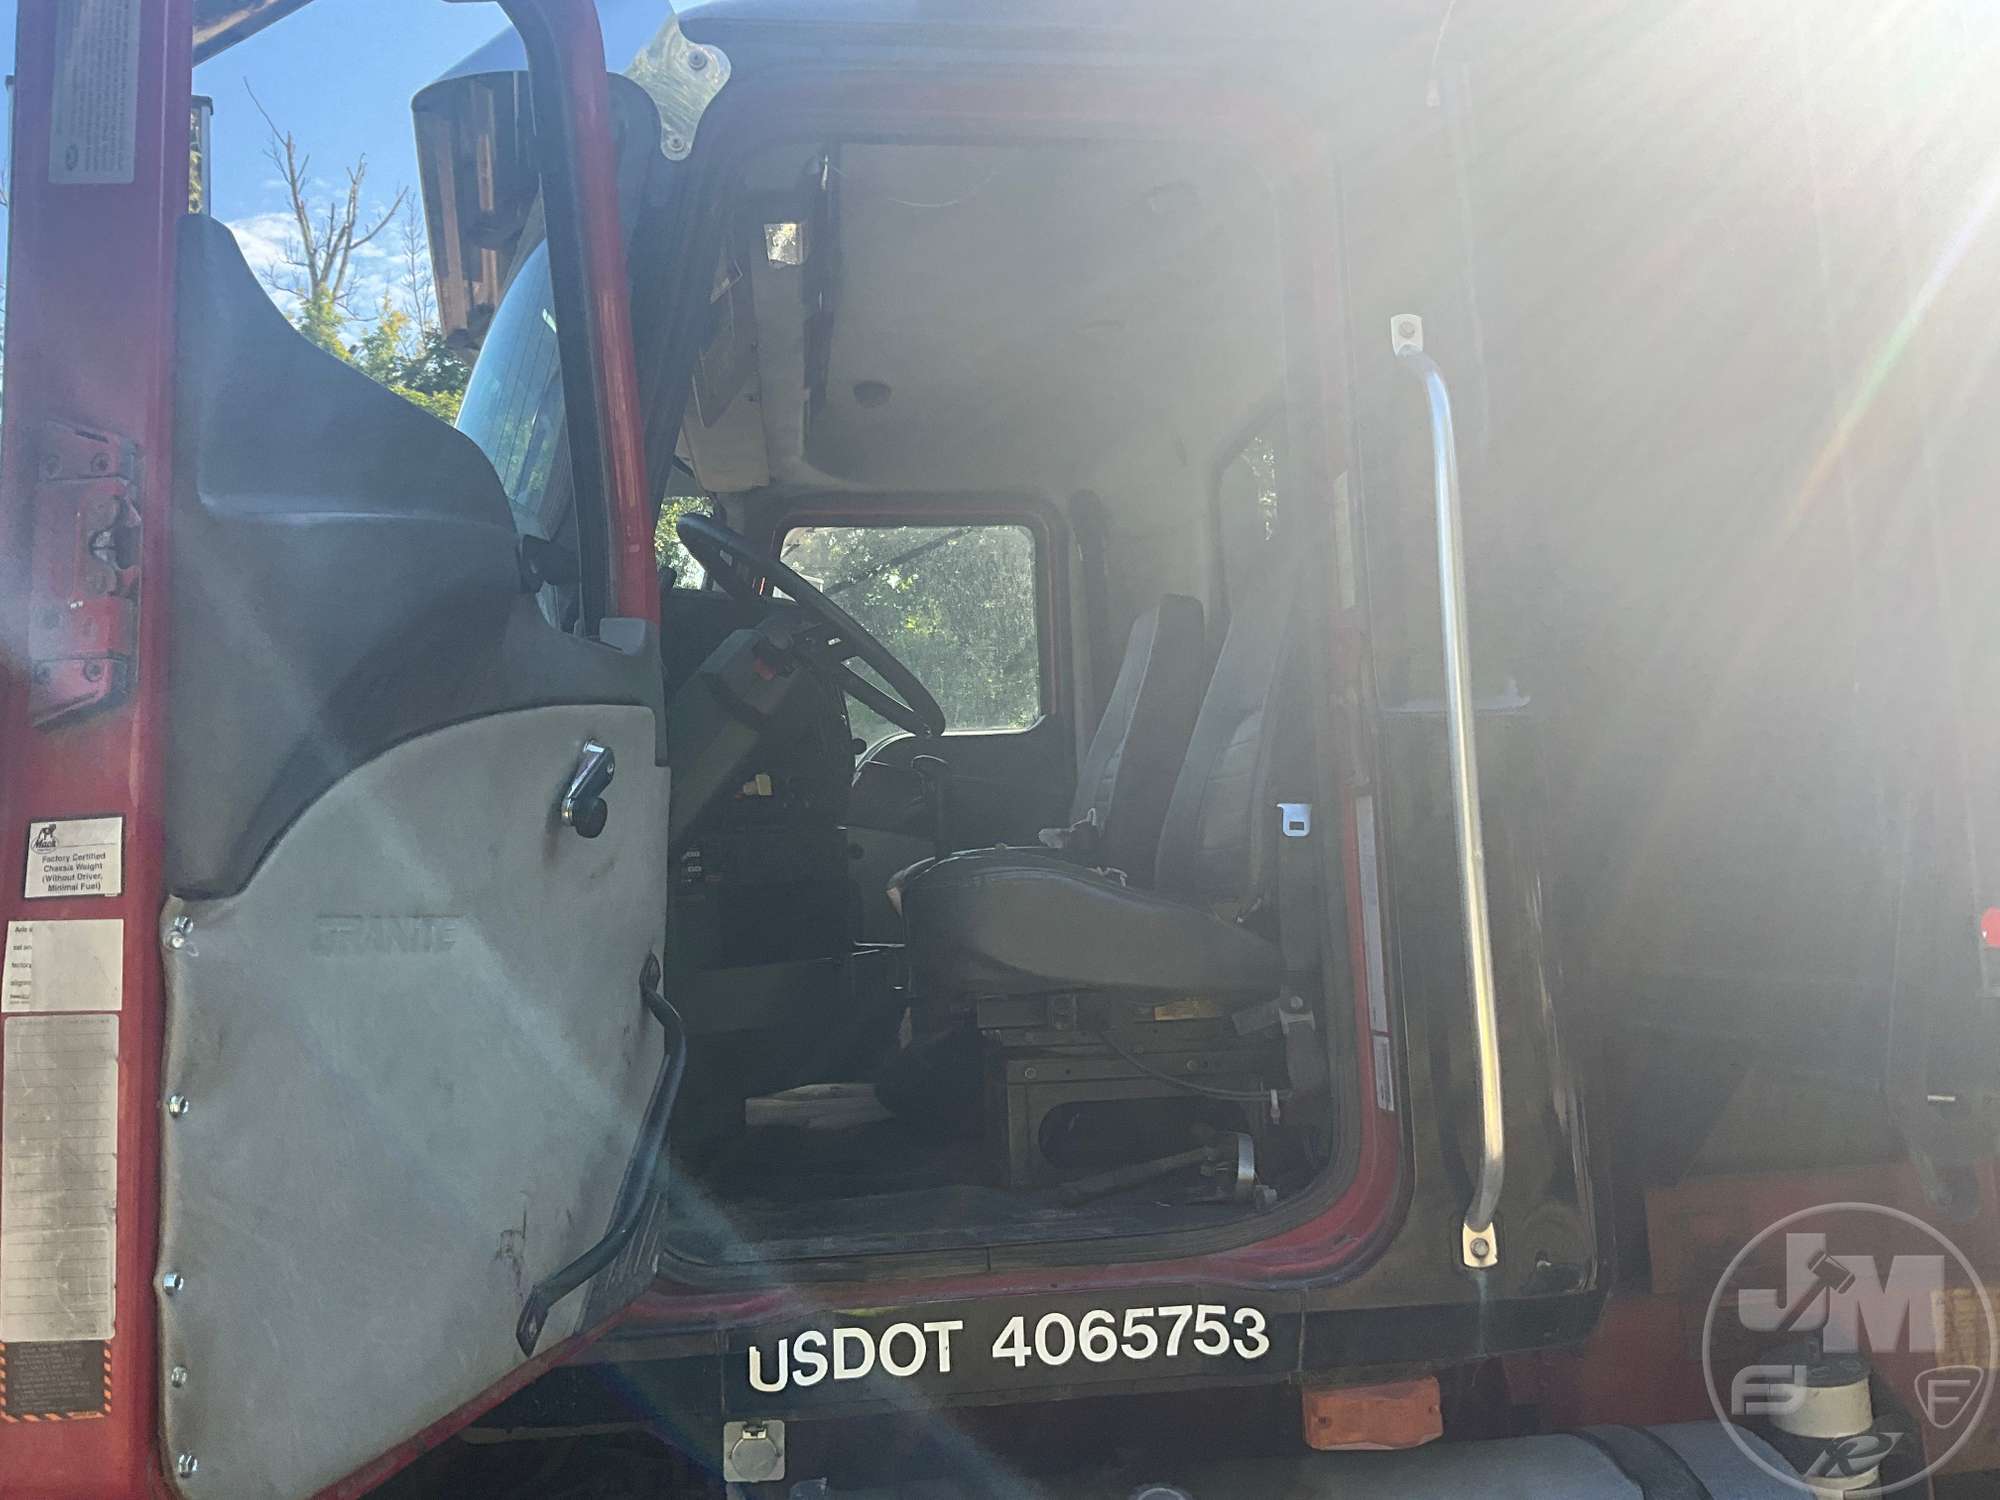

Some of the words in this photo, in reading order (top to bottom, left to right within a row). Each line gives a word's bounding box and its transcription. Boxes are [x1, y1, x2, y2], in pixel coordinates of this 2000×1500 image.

[42, 855, 70, 864] Factory
[72, 852, 106, 862] Certified
[43, 864, 73, 873] Chassis
[76, 862, 103, 872] Weight
[48, 883, 78, 893] Minimal
[748, 1319, 964, 1393] USDOT
[991, 1303, 1271, 1368] 4065753
